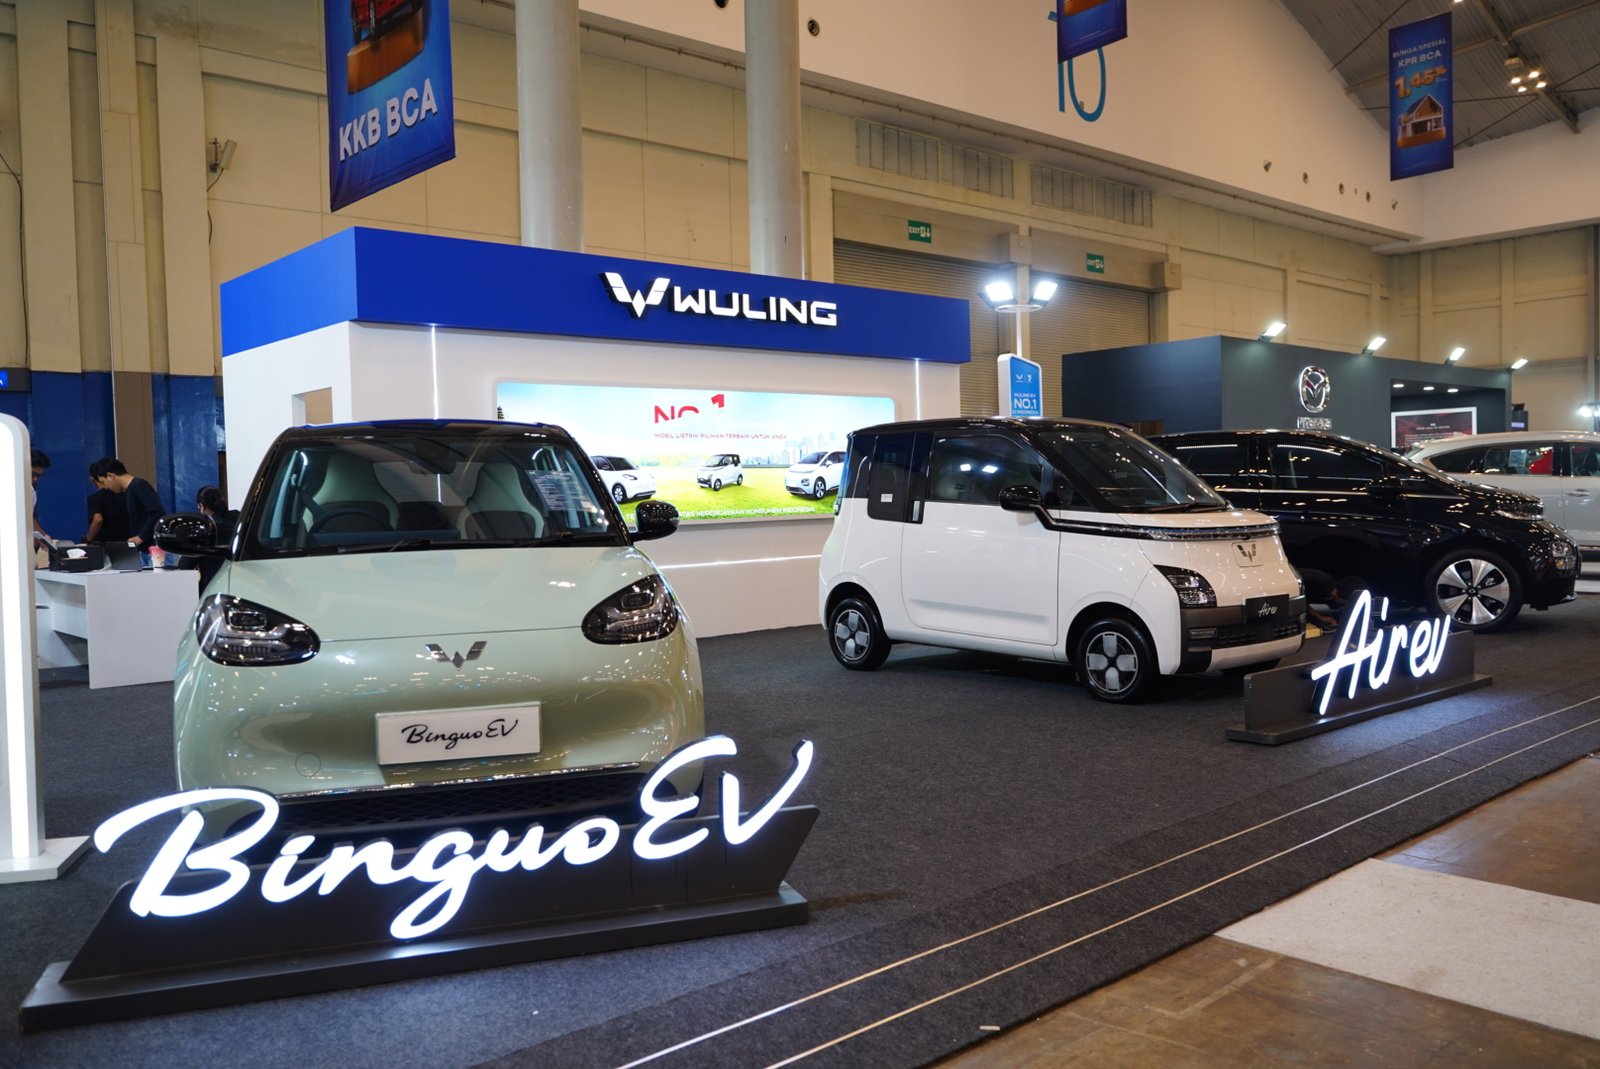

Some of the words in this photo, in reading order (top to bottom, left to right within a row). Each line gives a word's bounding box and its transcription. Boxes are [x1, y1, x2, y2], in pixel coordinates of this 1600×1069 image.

[1392, 47, 1418, 58] BUNGA
[1418, 38, 1447, 51] SPESIAL
[1398, 56, 1417, 69] KPR
[1420, 50, 1441, 62] BCA
[339, 108, 381, 161] KKB
[386, 78, 438, 137] BCA
[673, 286, 837, 326] WULING
[1013, 398, 1037, 409] NO.1
